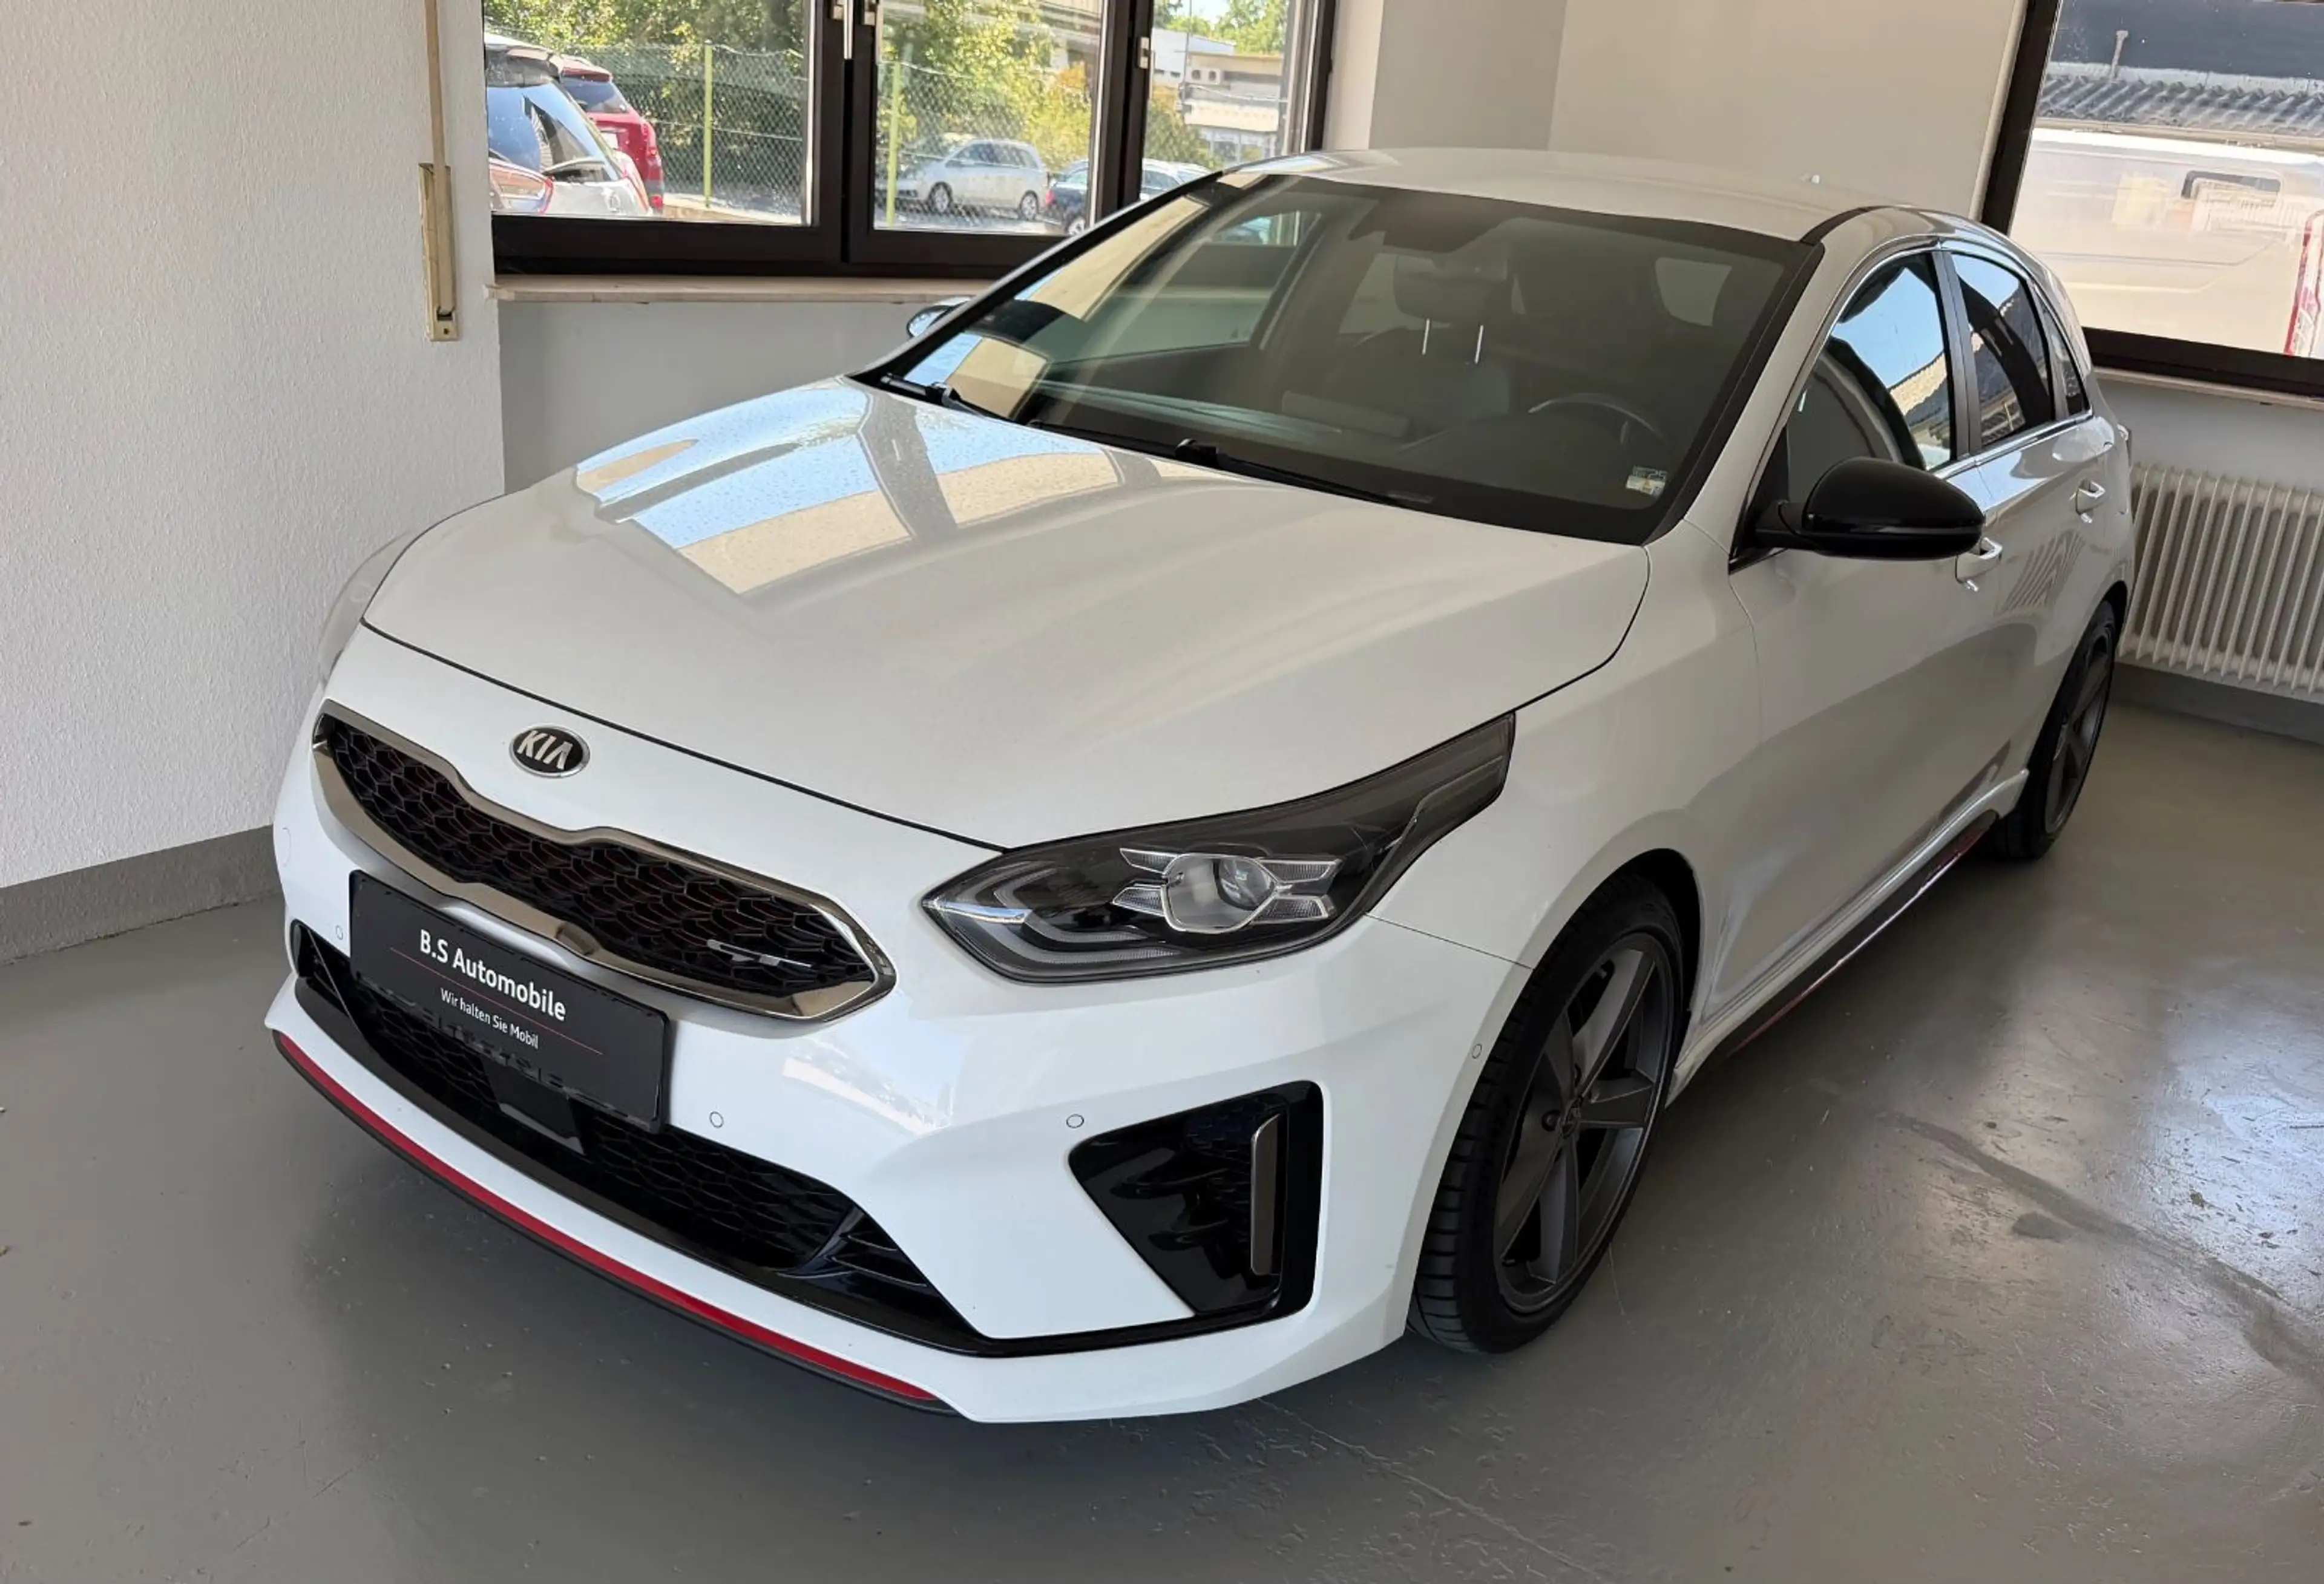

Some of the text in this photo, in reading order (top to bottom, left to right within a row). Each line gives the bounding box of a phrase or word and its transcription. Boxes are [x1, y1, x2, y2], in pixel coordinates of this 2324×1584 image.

[517, 730, 573, 770] KIA
[420, 929, 566, 1021] B.S Automobile
[440, 987, 539, 1050] Wir halten Sie Mobil
